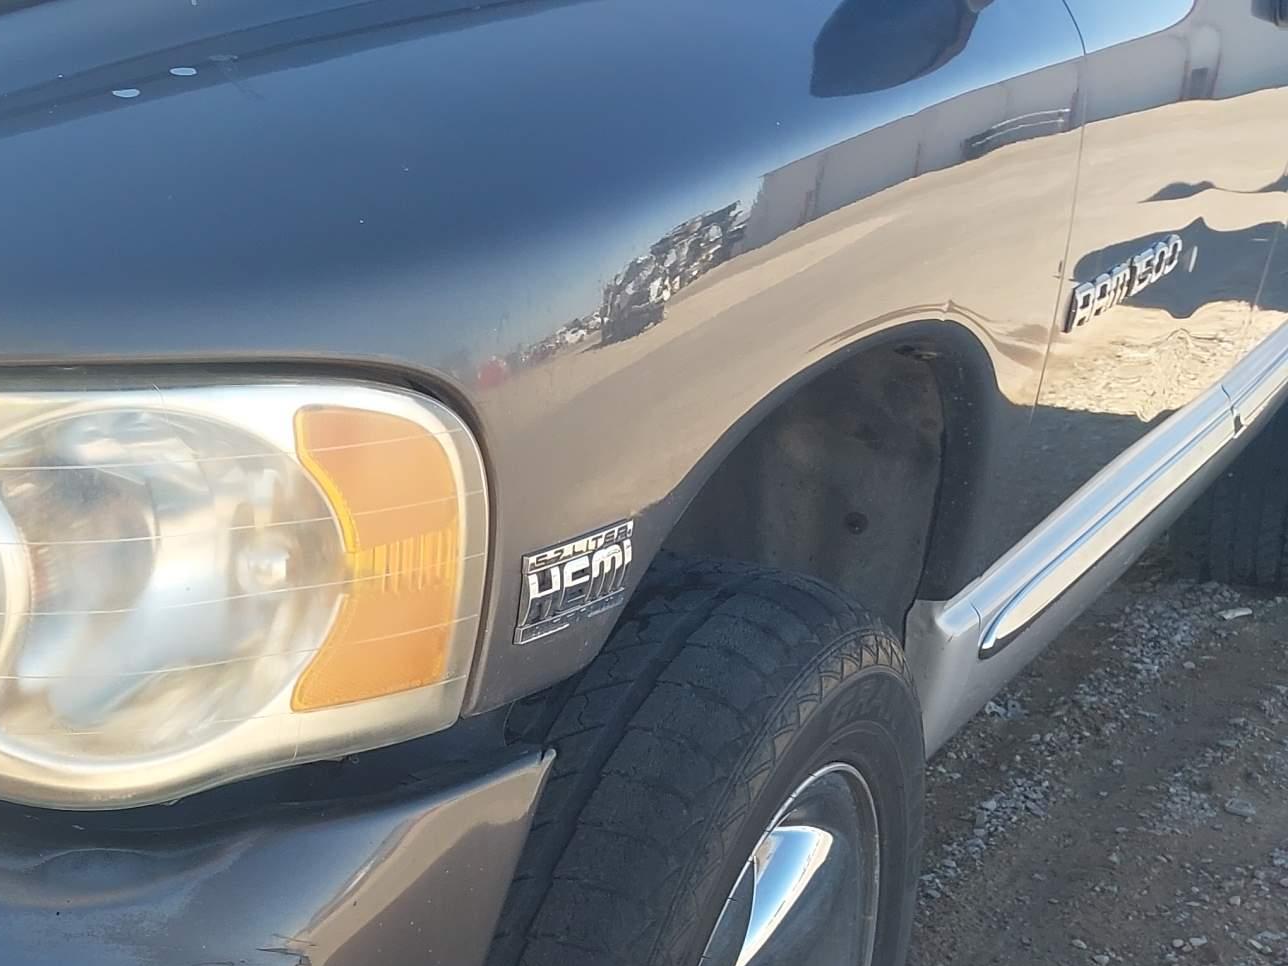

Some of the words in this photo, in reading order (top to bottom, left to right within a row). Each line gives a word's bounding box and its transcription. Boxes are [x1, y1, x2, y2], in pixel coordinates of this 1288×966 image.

[1064, 263, 1132, 331] RAM
[1127, 234, 1183, 297] 1500
[521, 537, 634, 626] HEMI
[570, 524, 630, 554] LITER
